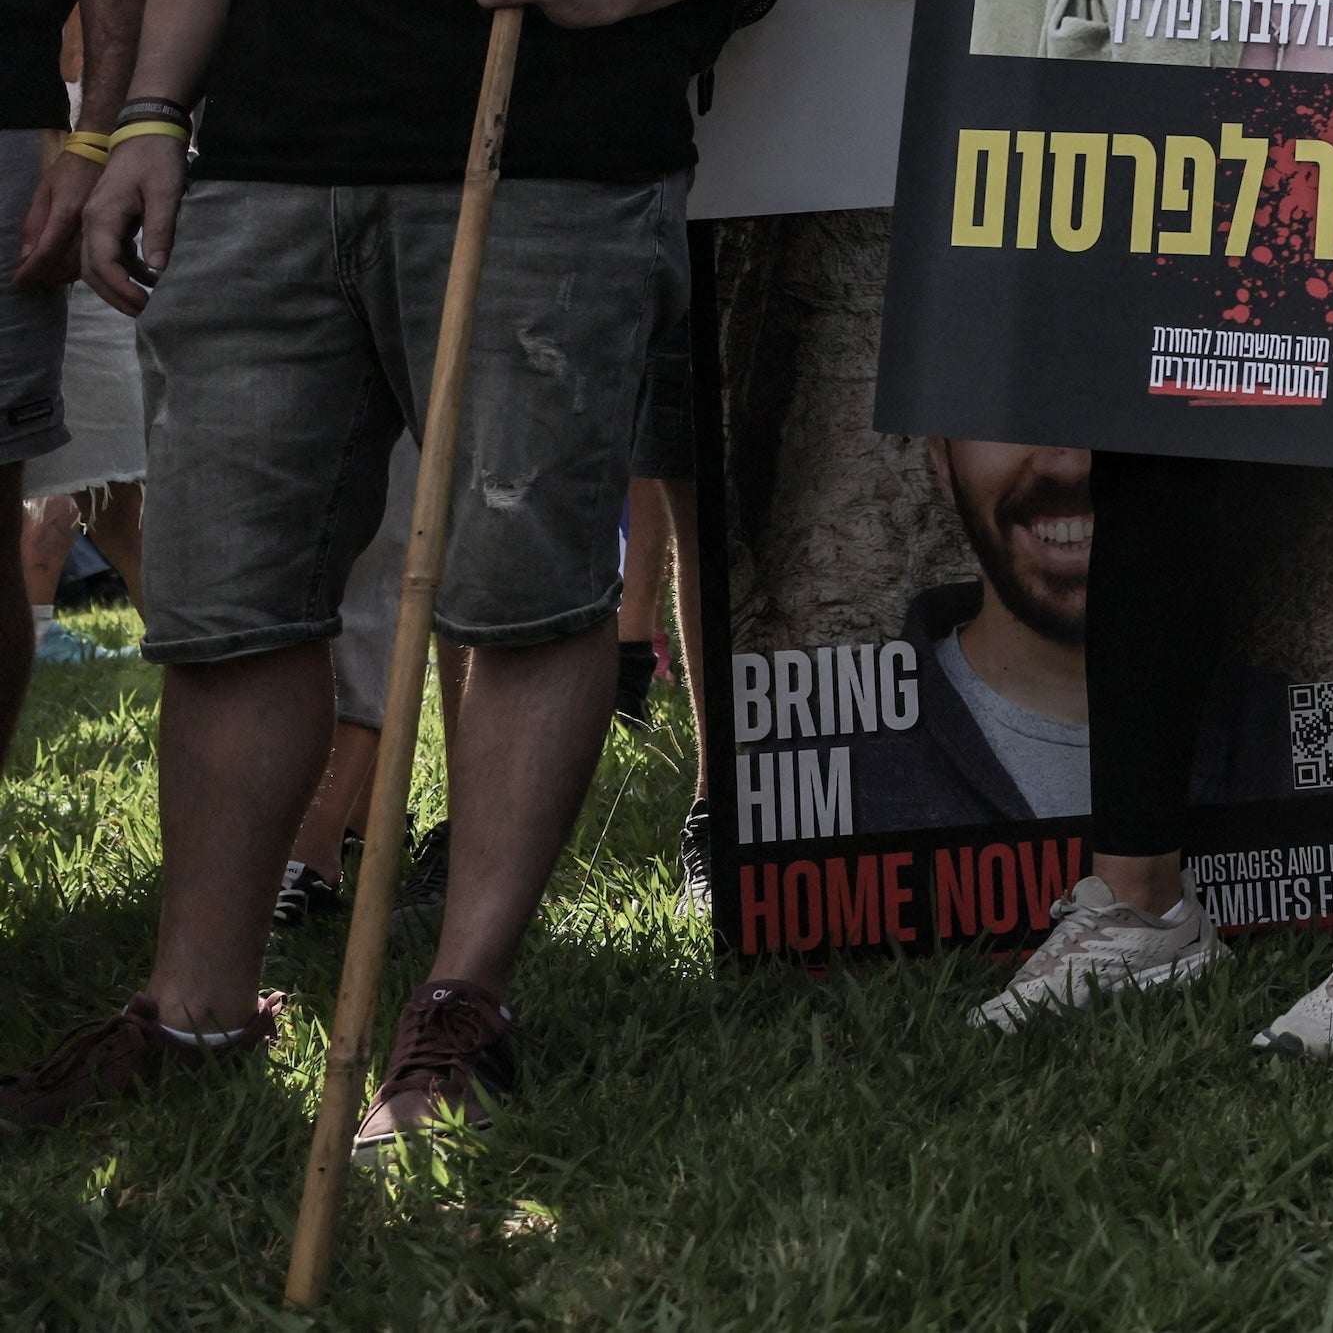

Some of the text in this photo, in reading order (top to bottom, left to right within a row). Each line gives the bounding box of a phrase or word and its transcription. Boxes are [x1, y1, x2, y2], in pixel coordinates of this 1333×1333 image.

[950, 122, 1269, 257] לפרסום
[1150, 355, 1330, 399] החטופים והנעדרים
[1152, 325, 1330, 363] מטה המשפחות להחזרת
[731, 639, 919, 744] BRING
[736, 746, 854, 845] HIM
[738, 850, 918, 956] HOME
[1187, 848, 1283, 884] HOSTAGES
[1288, 844, 1325, 877] AND
